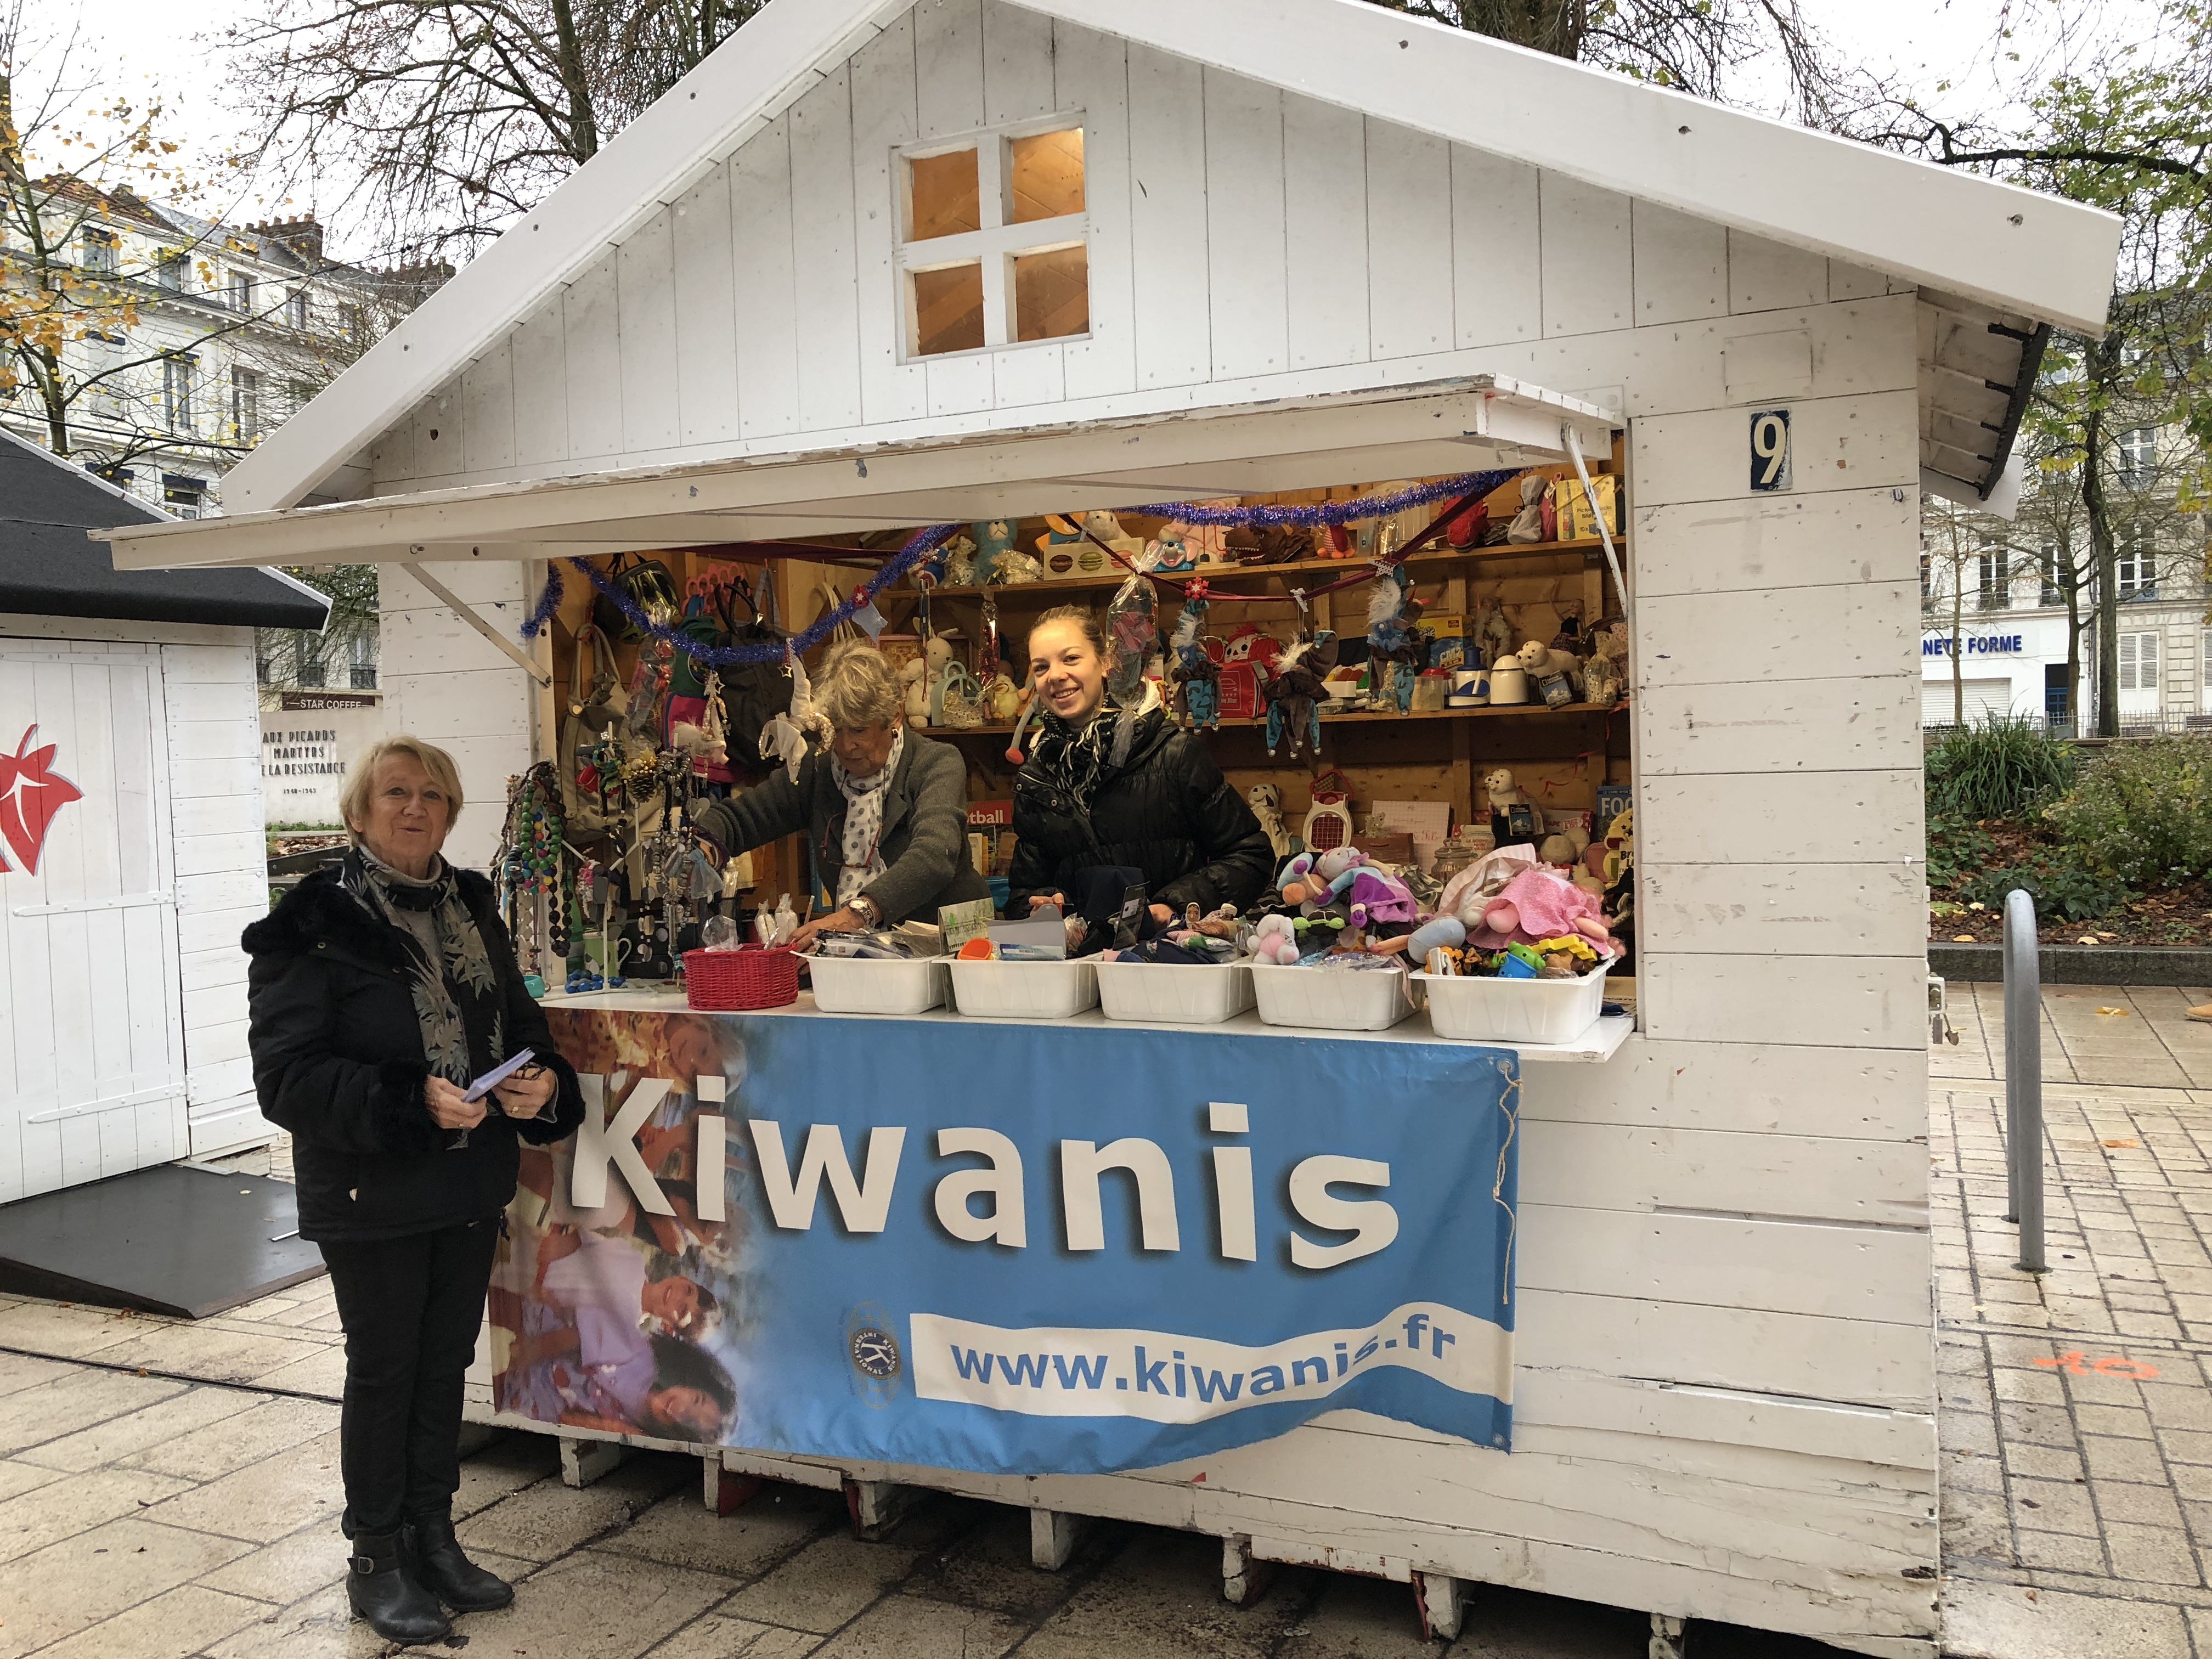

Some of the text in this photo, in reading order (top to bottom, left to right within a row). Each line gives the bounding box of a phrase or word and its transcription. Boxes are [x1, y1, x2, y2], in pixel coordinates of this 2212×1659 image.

[1754, 415, 1787, 484] 9
[1968, 635, 2023, 653] FORME
[300, 699, 362, 709] STAR COFFEE
[262, 729, 336, 743] AUX PICARDS
[274, 746, 325, 759] MARTYRS
[268, 764, 281, 776] LA
[284, 761, 346, 775] RESISTANCE
[569, 1073, 1400, 1270] Kiwanis
[949, 1313, 1455, 1403] www.kiwanis.fr
